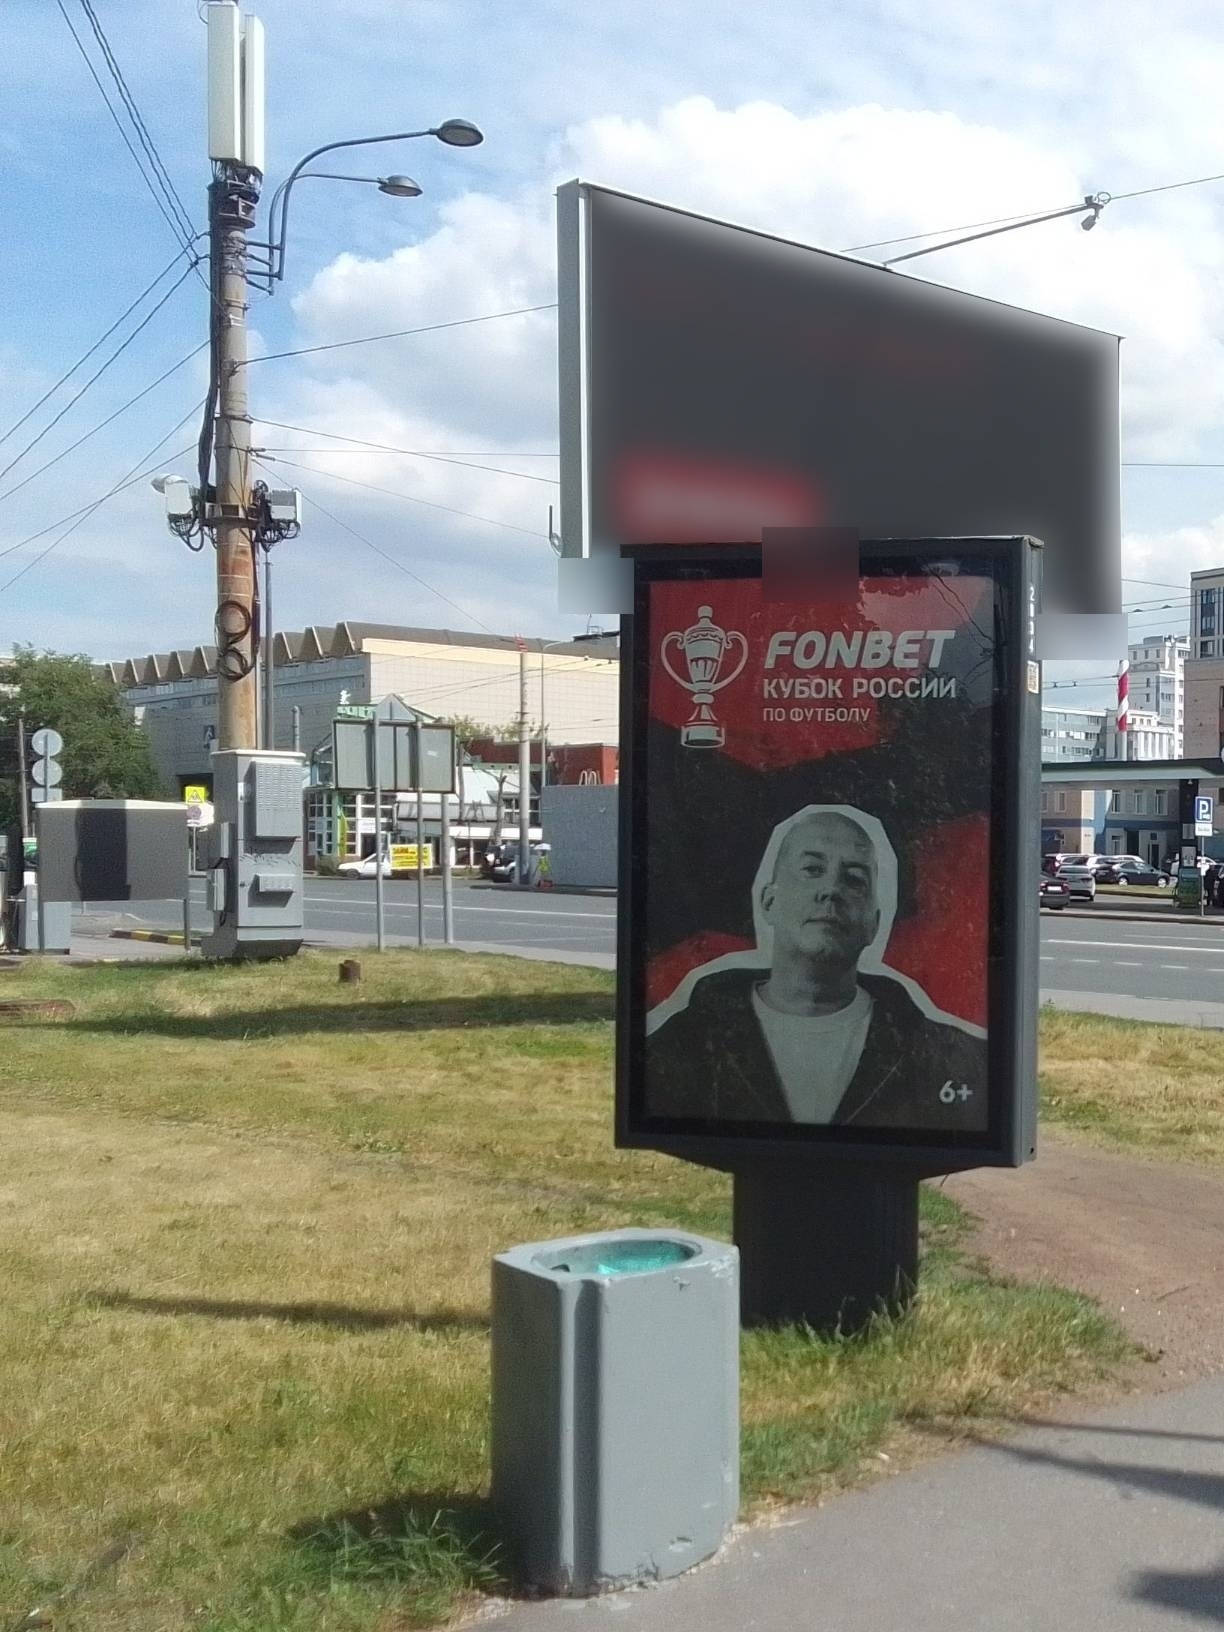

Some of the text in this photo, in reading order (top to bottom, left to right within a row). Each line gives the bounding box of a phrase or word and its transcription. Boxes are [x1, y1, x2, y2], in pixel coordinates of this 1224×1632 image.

[764, 629, 956, 669] FONBET
[763, 676, 956, 699] КУБОК РОССИИ
[763, 707, 871, 722] ПО ФУТБОЛУ
[939, 1080, 973, 1103] 6+
